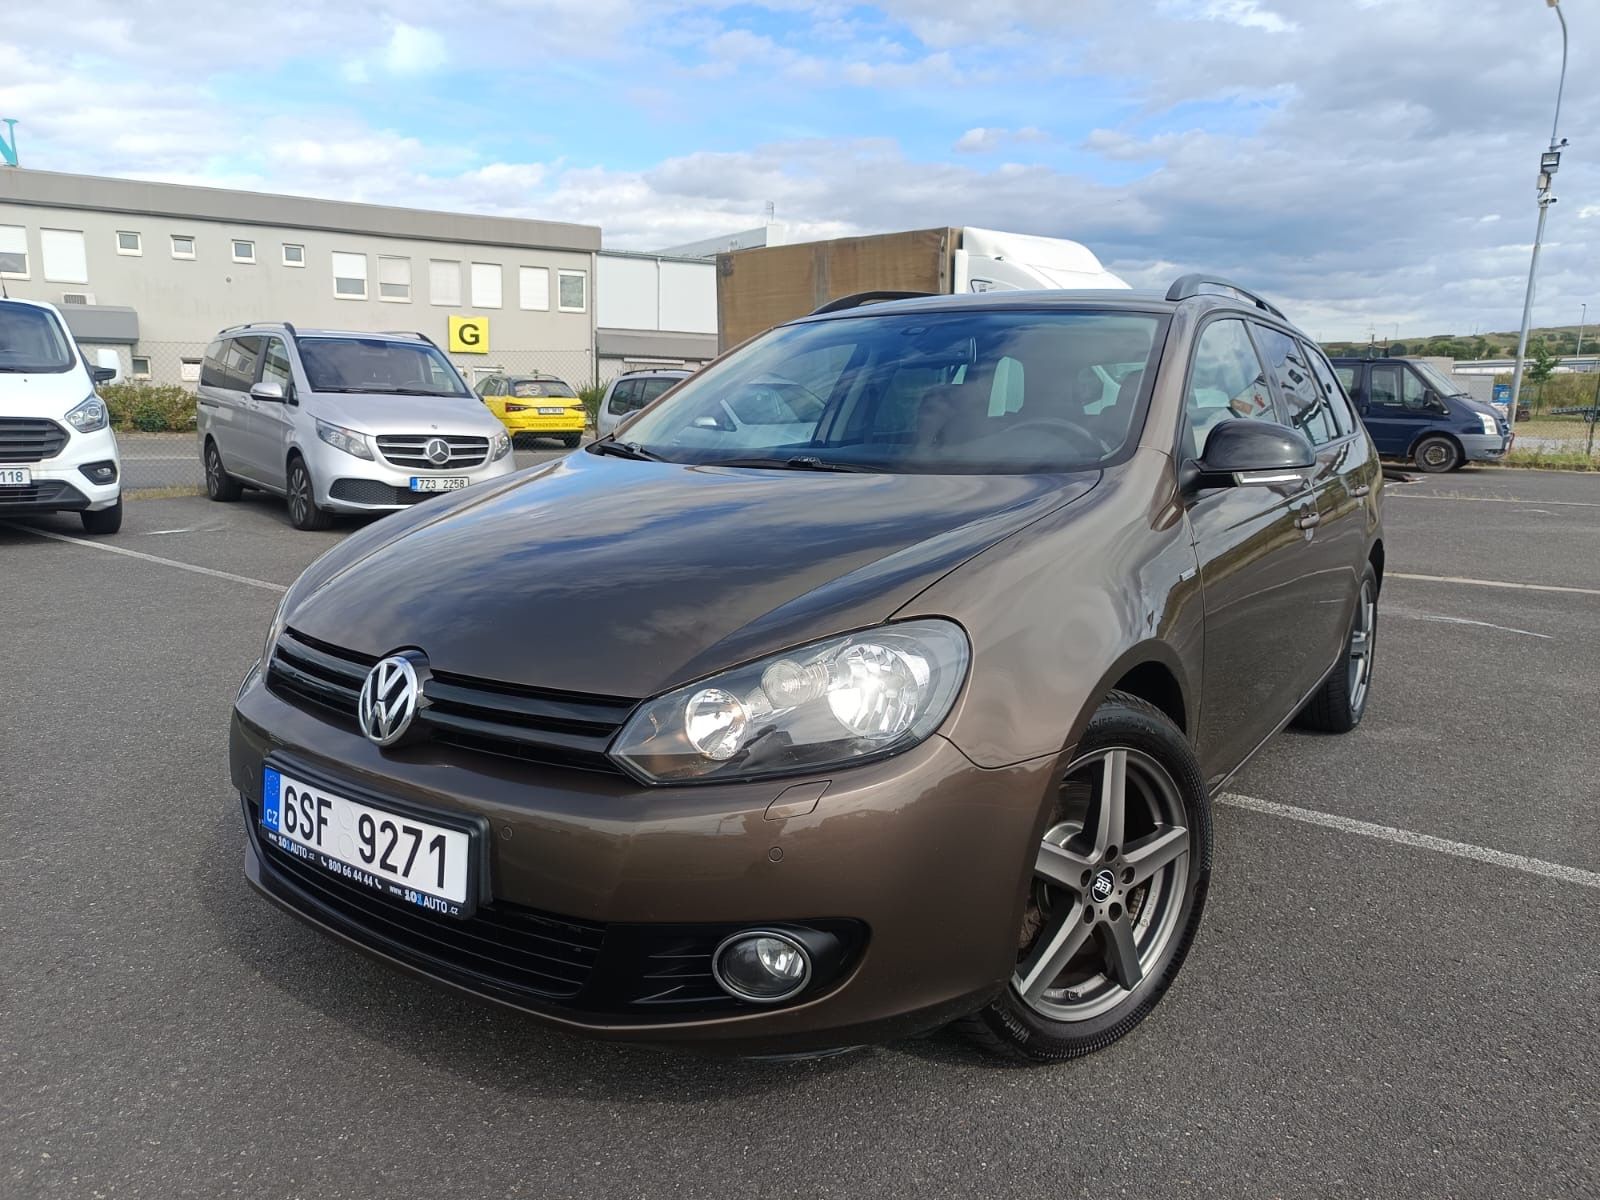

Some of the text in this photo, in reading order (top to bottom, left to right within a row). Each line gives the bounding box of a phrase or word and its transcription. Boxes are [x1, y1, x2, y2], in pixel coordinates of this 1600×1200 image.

[458, 323, 480, 346] G
[419, 479, 465, 489] 7Z3 2258
[266, 808, 278, 824] CZ
[284, 785, 447, 889] 6SF 9271
[328, 859, 341, 874] 800
[342, 865, 352, 878] 66
[353, 869, 362, 883] 44
[363, 874, 373, 887] 44
